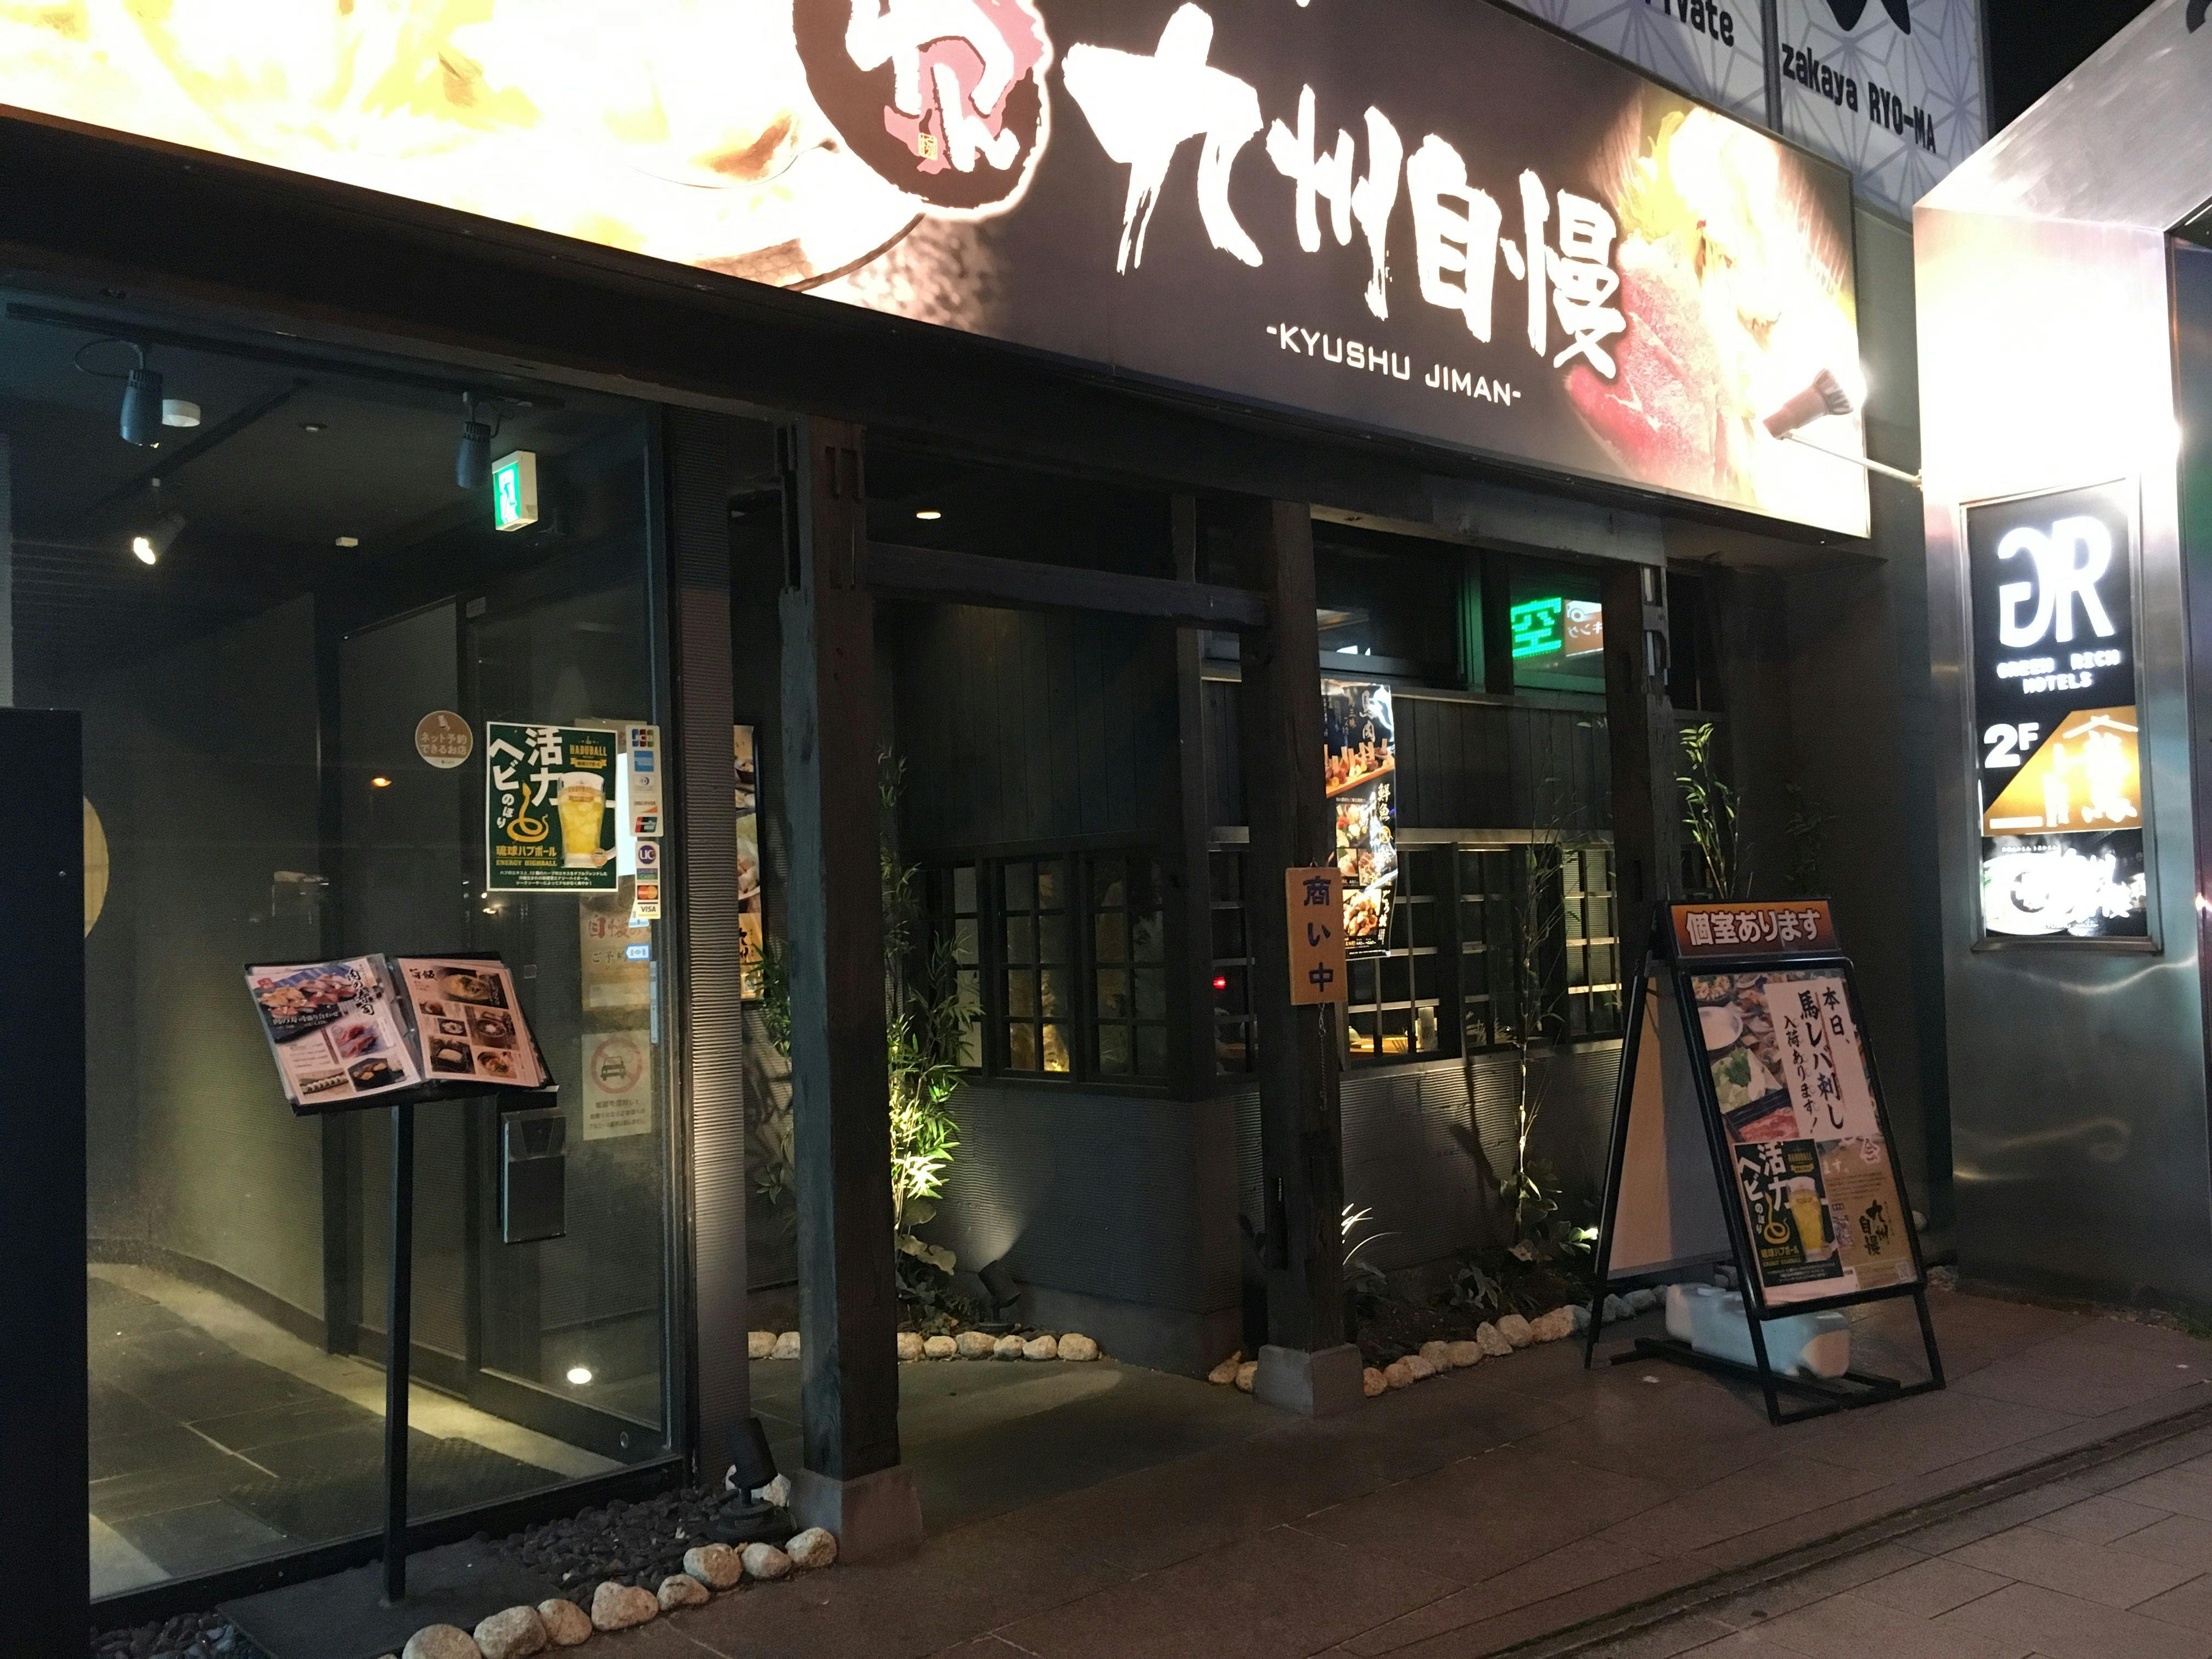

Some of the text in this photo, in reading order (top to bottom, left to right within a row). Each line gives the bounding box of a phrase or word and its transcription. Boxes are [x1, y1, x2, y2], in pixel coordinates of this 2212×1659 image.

[1782, 43, 1937, 154] zakaya RYO-MA
[1062, 2, 1626, 379] 九州自慢
[2023, 672, 2092, 694] HOTELS
[420, 732, 467, 744] ネット予約
[1984, 722, 2039, 768] 2F
[495, 845, 557, 856] 琉球ハブボール
[1303, 877, 1333, 992] 商い中
[1686, 909, 1821, 946] 個室あります
[347, 968, 375, 1015] 肉の寿司
[1797, 989, 1844, 1130] 馬レバ刺し
